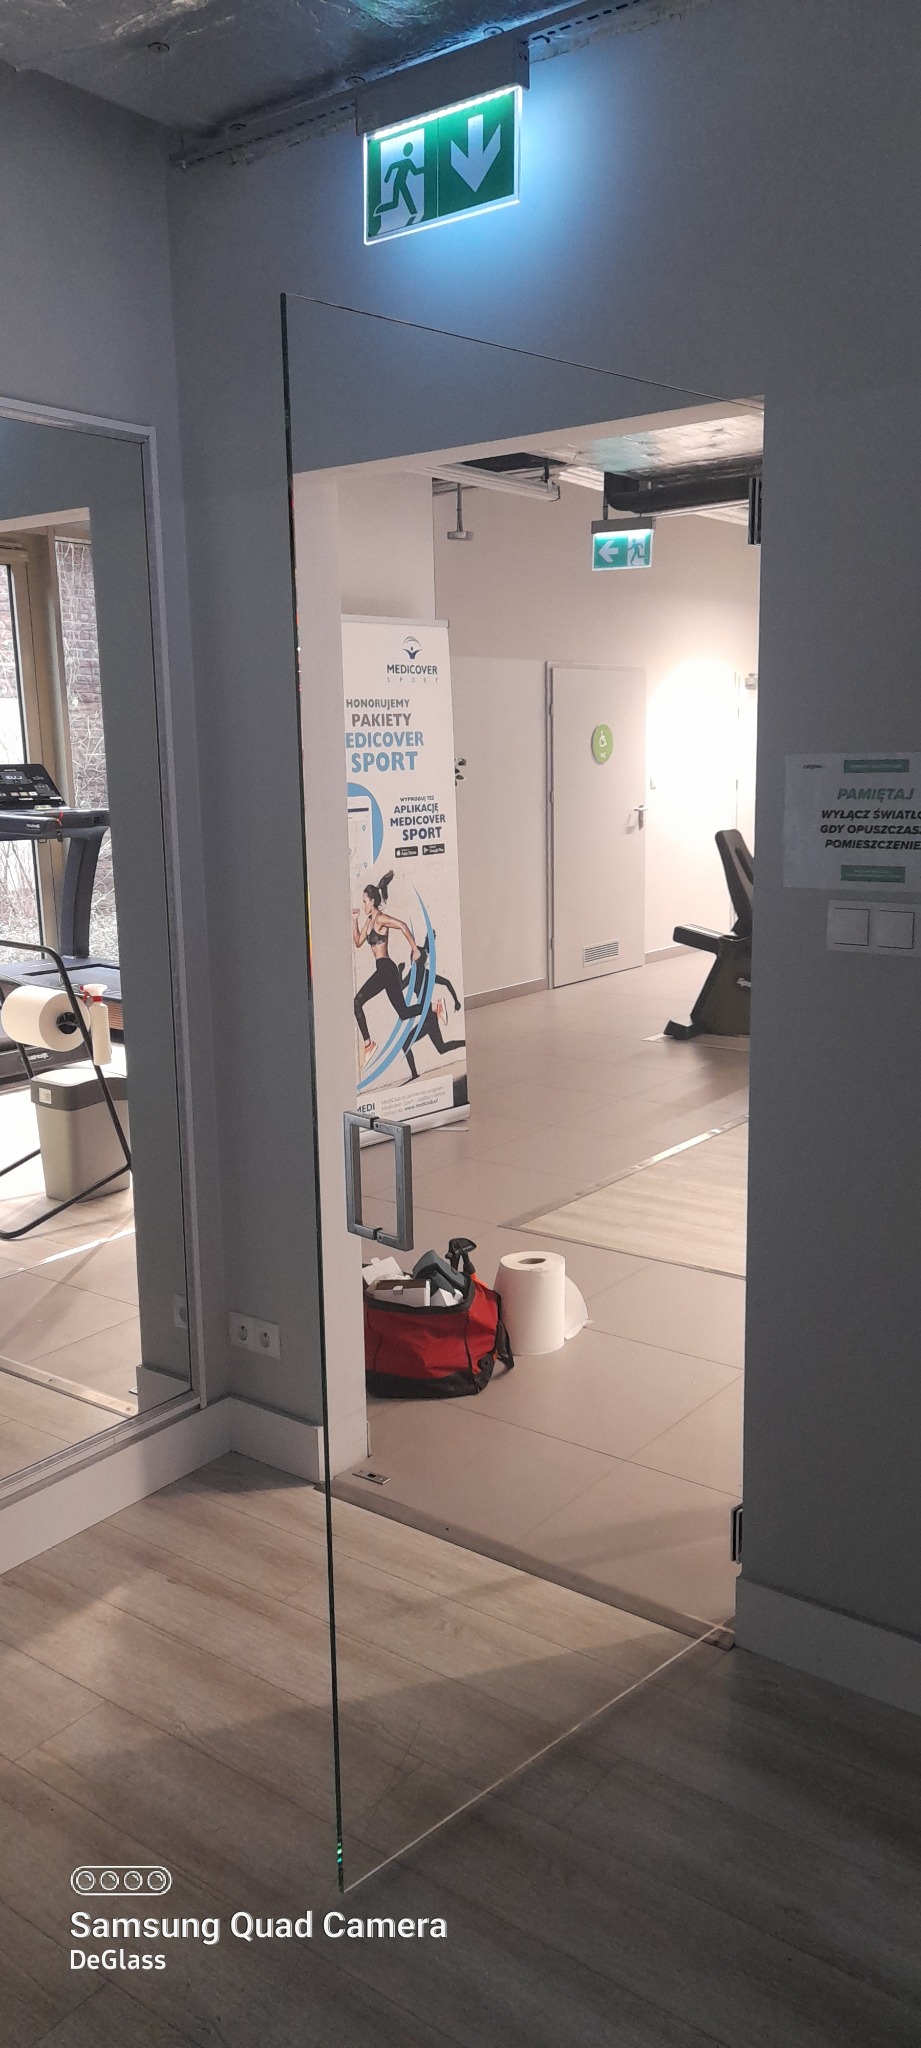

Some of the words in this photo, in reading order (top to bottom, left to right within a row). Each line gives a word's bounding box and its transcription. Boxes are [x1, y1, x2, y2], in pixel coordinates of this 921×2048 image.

[386, 664, 438, 675] MEDICOVER
[346, 698, 410, 710] HONORUJEMY
[351, 713, 411, 727] PAKIETY
[345, 731, 424, 748] EDICOVER
[351, 751, 418, 773] SPORT
[837, 788, 914, 803] PAMIĘTAJ
[394, 803, 439, 814] APLIKACJĘ
[390, 814, 446, 827] MEDICOVER
[821, 810, 871, 821] WYŁĄCZ
[402, 826, 442, 841] SPORT
[820, 824, 845, 834] GDY
[846, 825, 921, 835] OPUSZCZAS
[825, 839, 921, 850] POMIESZCZENIE
